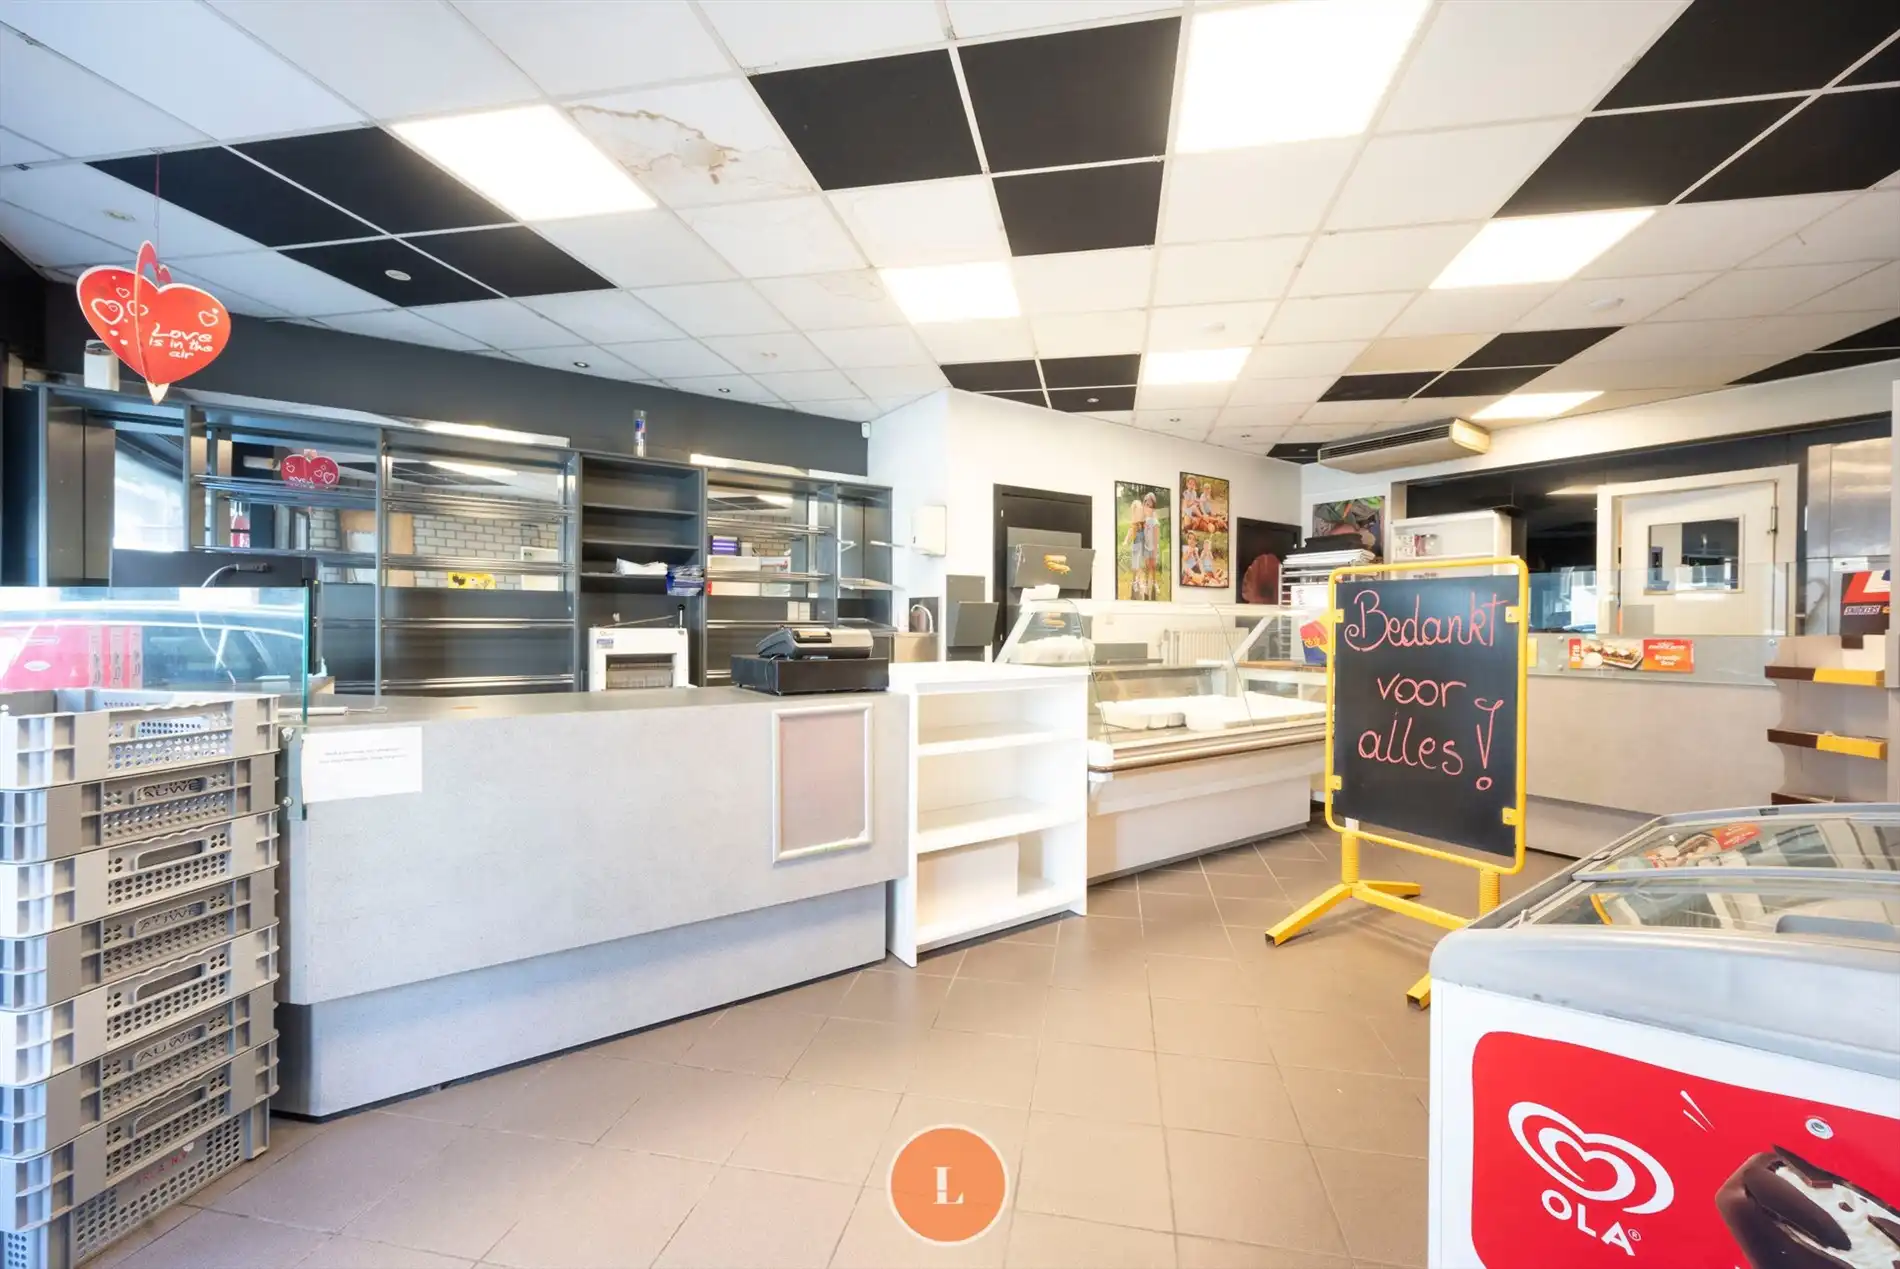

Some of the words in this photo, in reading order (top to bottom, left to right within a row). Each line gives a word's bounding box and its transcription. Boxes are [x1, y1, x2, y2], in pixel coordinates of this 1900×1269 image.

[151, 322, 212, 342] Love
[169, 349, 194, 359] air
[189, 339, 213, 352] the
[1344, 589, 1508, 652] Bedankt
[1377, 673, 1466, 708] voor
